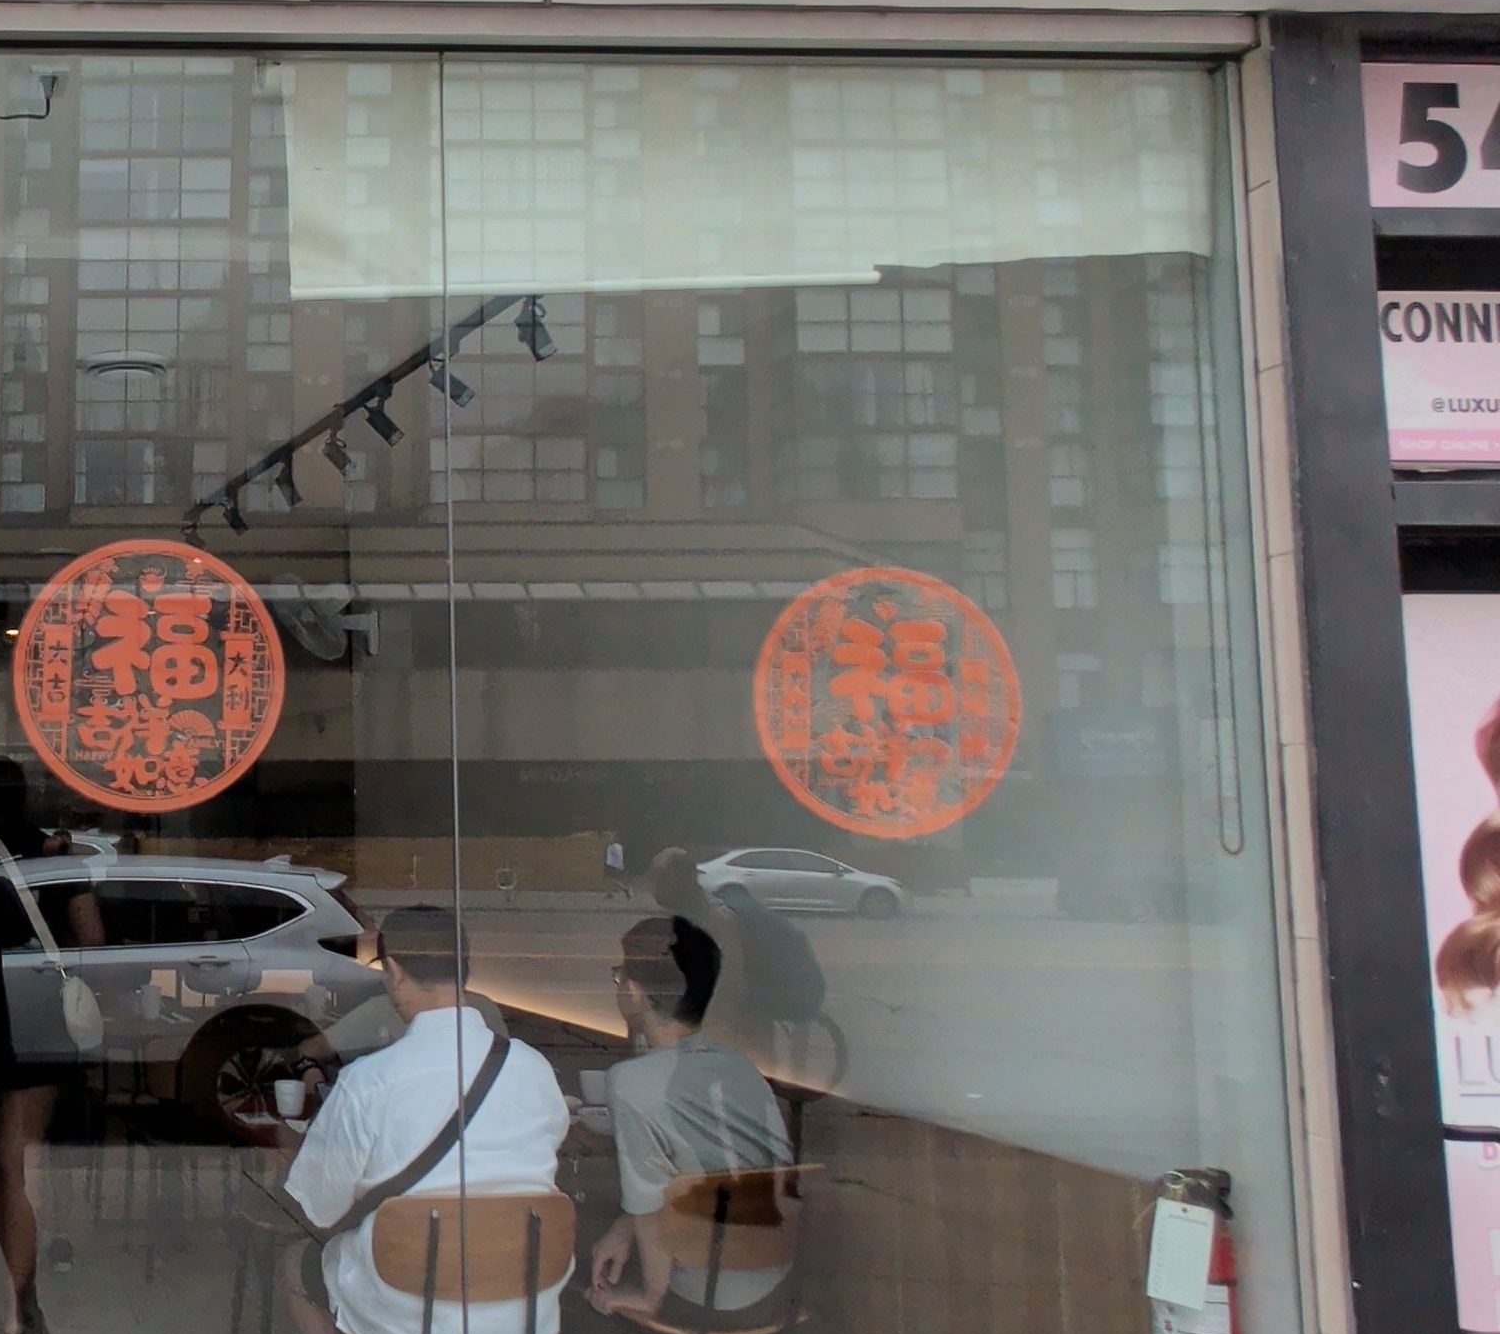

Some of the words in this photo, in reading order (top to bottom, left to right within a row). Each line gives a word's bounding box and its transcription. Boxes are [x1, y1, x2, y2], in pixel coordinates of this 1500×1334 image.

[1397, 82, 1500, 194] 5
[1380, 302, 1500, 343] CONN
[92, 589, 219, 701] 福
[829, 617, 954, 726] 福
